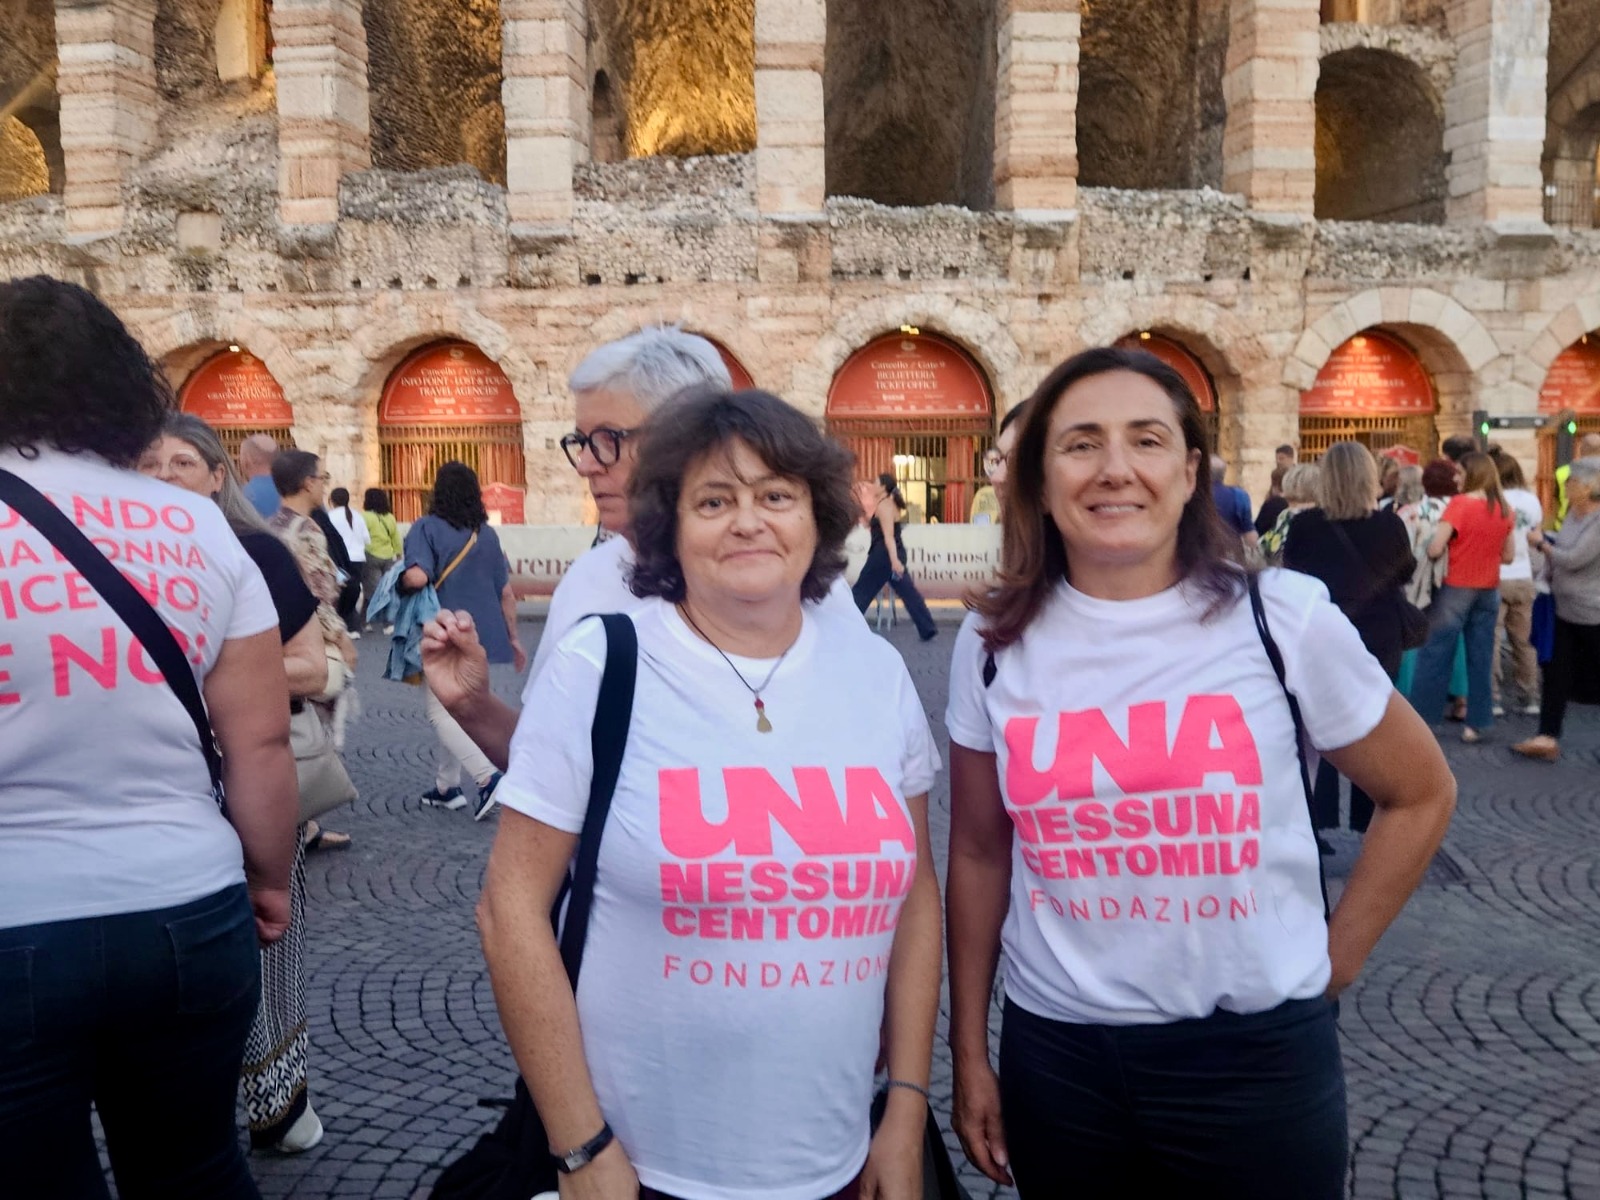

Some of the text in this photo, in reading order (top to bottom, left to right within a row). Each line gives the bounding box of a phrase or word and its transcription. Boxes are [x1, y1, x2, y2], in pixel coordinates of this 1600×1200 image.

[419, 386, 500, 396] TRAVEL AGENCIES
[485, 376, 511, 385] FOUN
[876, 380, 938, 390] TICKET OFFICE
[877, 370, 936, 380] BIGLIETTERIA
[910, 547, 941, 562] The
[946, 550, 989, 562] most
[911, 566, 959, 582] place
[963, 570, 986, 580] on
[1004, 693, 1264, 807] UNA
[658, 765, 917, 860] UNA
[1007, 792, 1261, 844] NESSUNA
[1020, 838, 1260, 880] CENTOMILA
[662, 903, 902, 941] CENTOMIL
[1030, 889, 1258, 924] FONDAZION
[663, 953, 889, 988] FONDAZION
